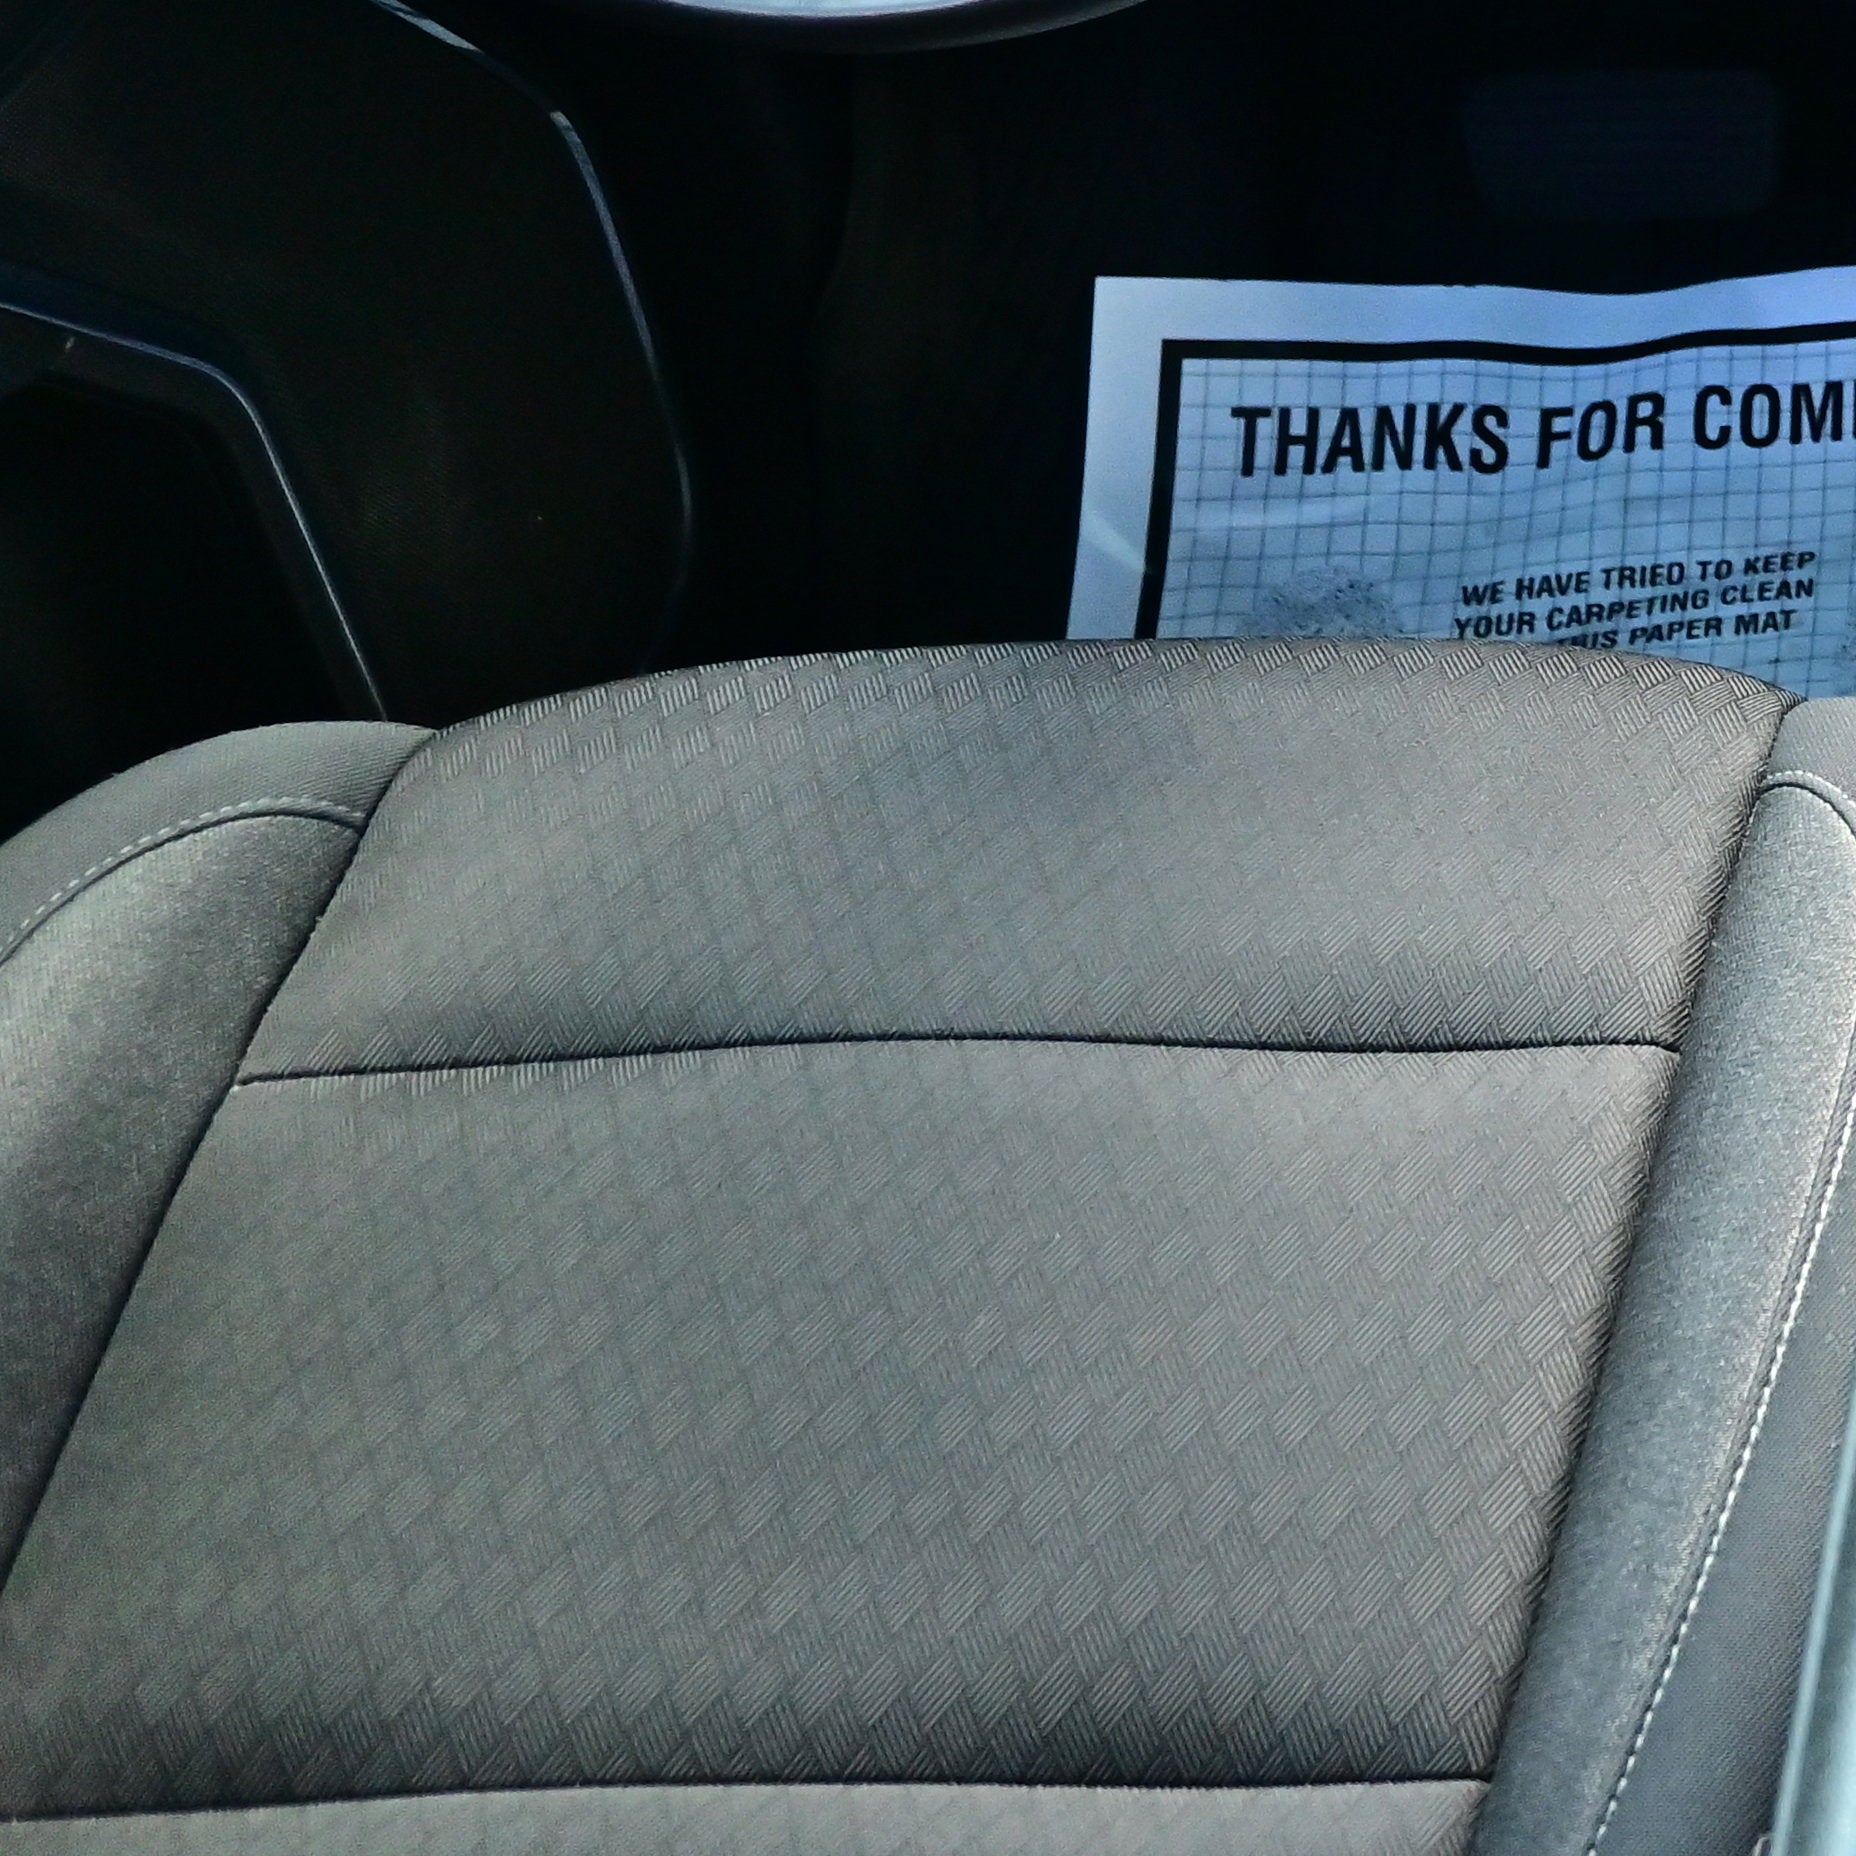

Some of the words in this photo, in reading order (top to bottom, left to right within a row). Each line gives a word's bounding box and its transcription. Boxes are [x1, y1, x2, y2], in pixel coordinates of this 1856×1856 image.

[1230, 401, 1510, 478] THANKS
[1535, 391, 1666, 470] FOR
[1453, 610, 1536, 640] YOUR
[1545, 588, 1711, 633] CARPETING
[1719, 577, 1815, 607] CLEAN
[1461, 580, 1506, 608] WE
[1514, 570, 1592, 602] HAVE
[1600, 561, 1687, 592] TRIED
[1696, 558, 1734, 582] TO
[1742, 551, 1817, 576] KEEP
[1627, 615, 1724, 646] PAPER
[1733, 608, 1798, 635] MAT
